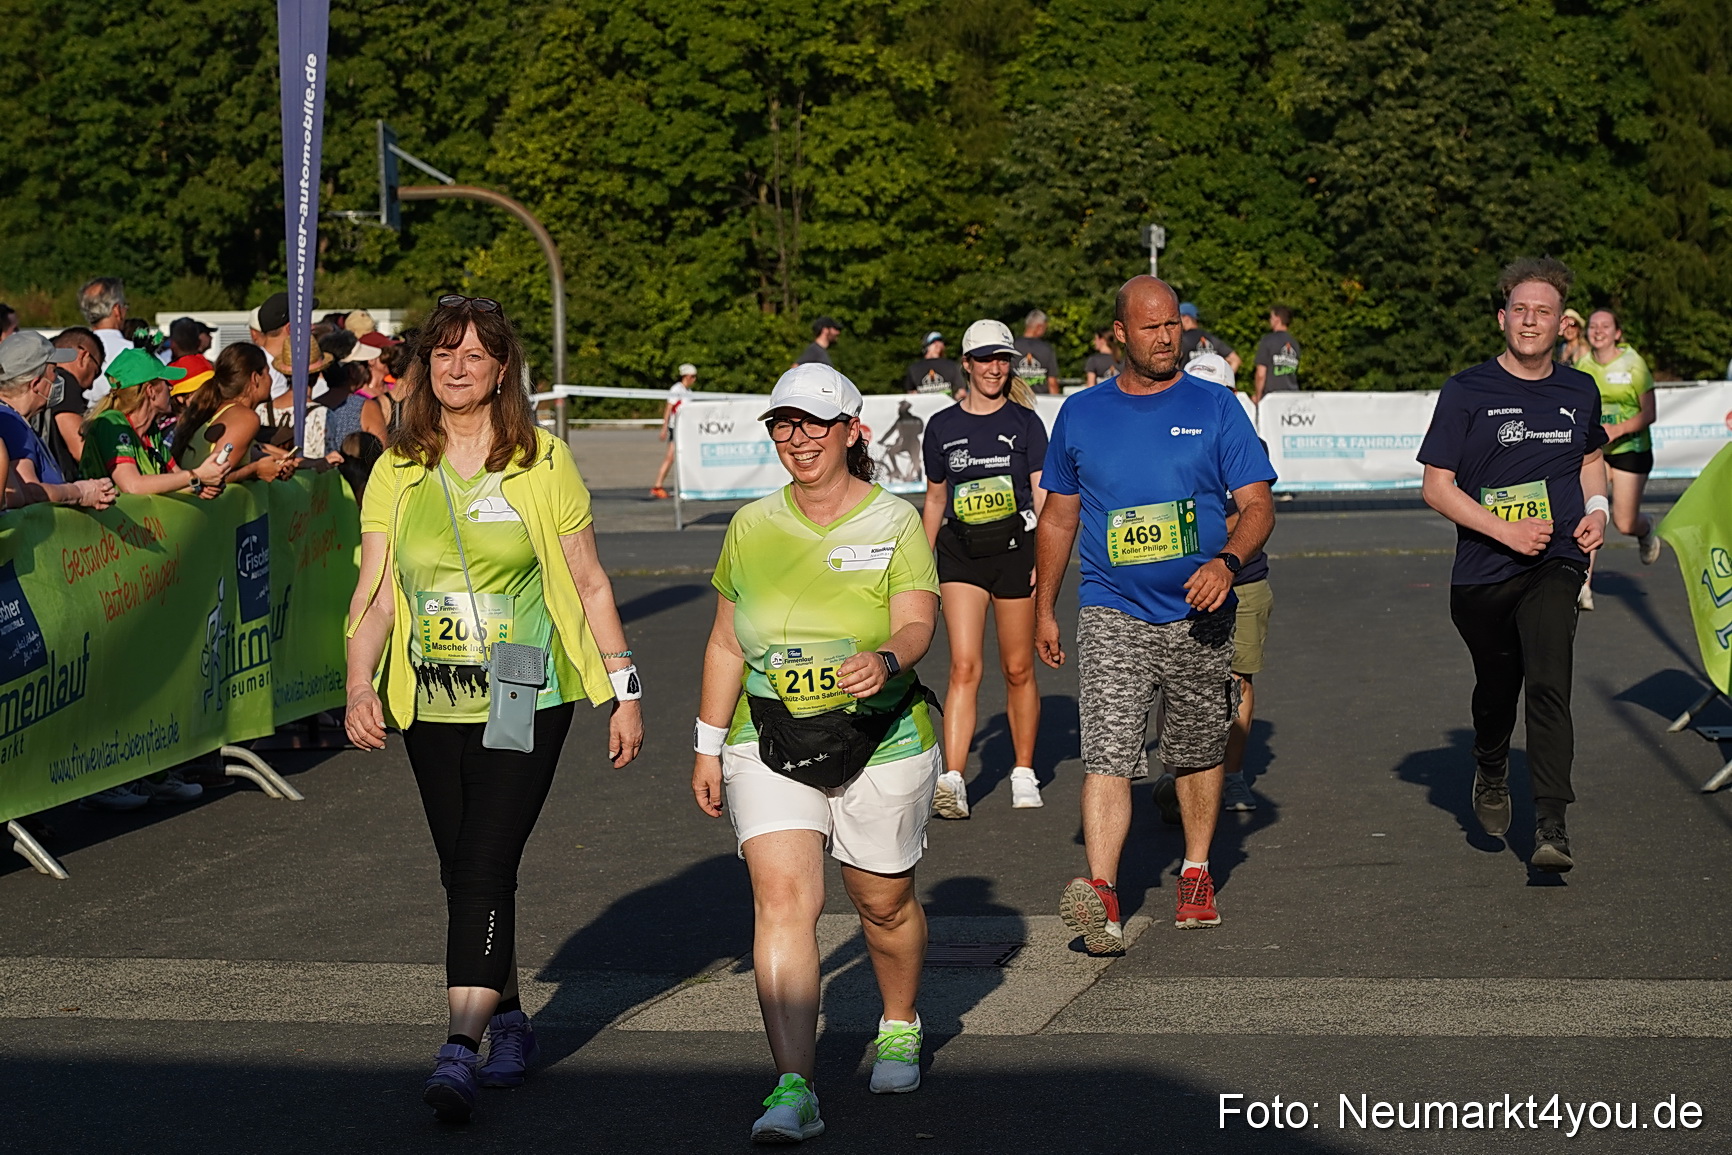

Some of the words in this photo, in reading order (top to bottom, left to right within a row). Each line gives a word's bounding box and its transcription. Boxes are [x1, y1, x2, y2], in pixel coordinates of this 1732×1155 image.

[699, 422, 735, 434] NOW
[1281, 414, 1316, 427] NOW
[1181, 428, 1202, 436] Berger
[1525, 429, 1572, 440] Firmenlauf
[968, 454, 1011, 466] Firmenlauf
[964, 492, 1005, 511] 1790
[1539, 501, 1547, 519] 022
[1124, 525, 1162, 545] 469
[1169, 524, 1179, 550] 2022
[62, 524, 119, 584] Gesunde
[117, 516, 168, 556] Firmen
[1111, 532, 1119, 559] WALK
[1121, 547, 1141, 555] Koller
[1143, 544, 1168, 553] Philipp
[99, 572, 141, 623] laufen
[423, 619, 431, 653] WALK
[431, 642, 468, 651] Maschek
[785, 667, 836, 694] 215
